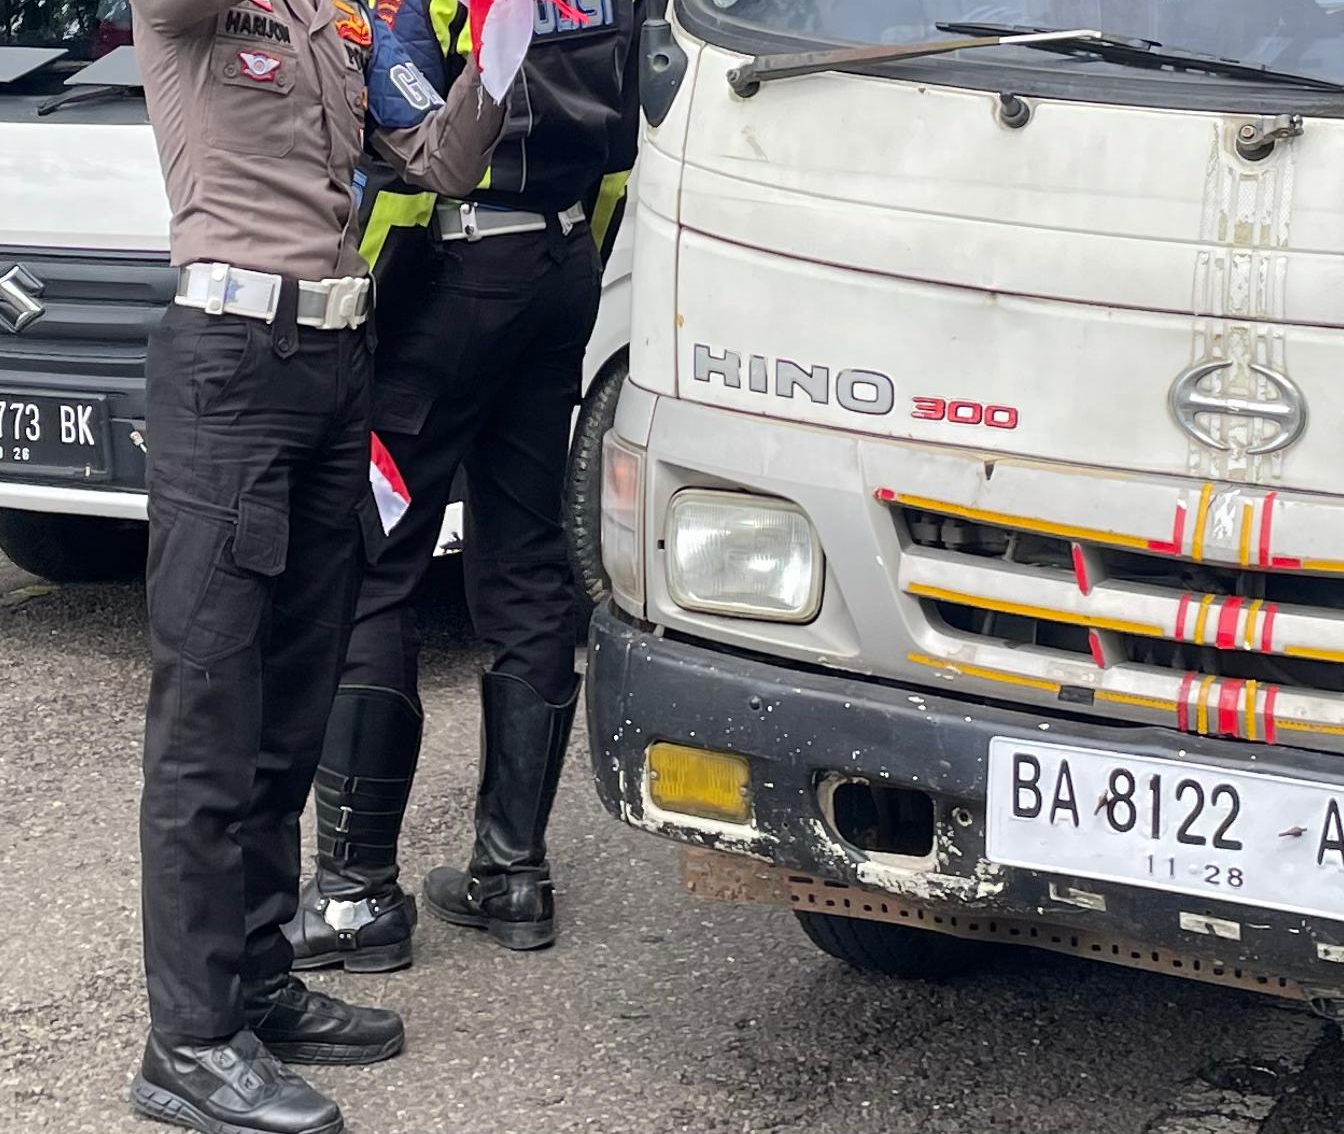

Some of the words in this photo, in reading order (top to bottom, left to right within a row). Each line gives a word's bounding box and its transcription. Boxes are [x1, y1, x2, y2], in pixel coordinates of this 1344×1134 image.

[693, 343, 896, 417] HINO
[910, 396, 1020, 431] 300
[59, 403, 96, 447] BK
[1011, 751, 1081, 829] BA
[1105, 765, 1244, 852] 8122
[1146, 853, 1177, 879] 11
[1203, 863, 1246, 889] 28
